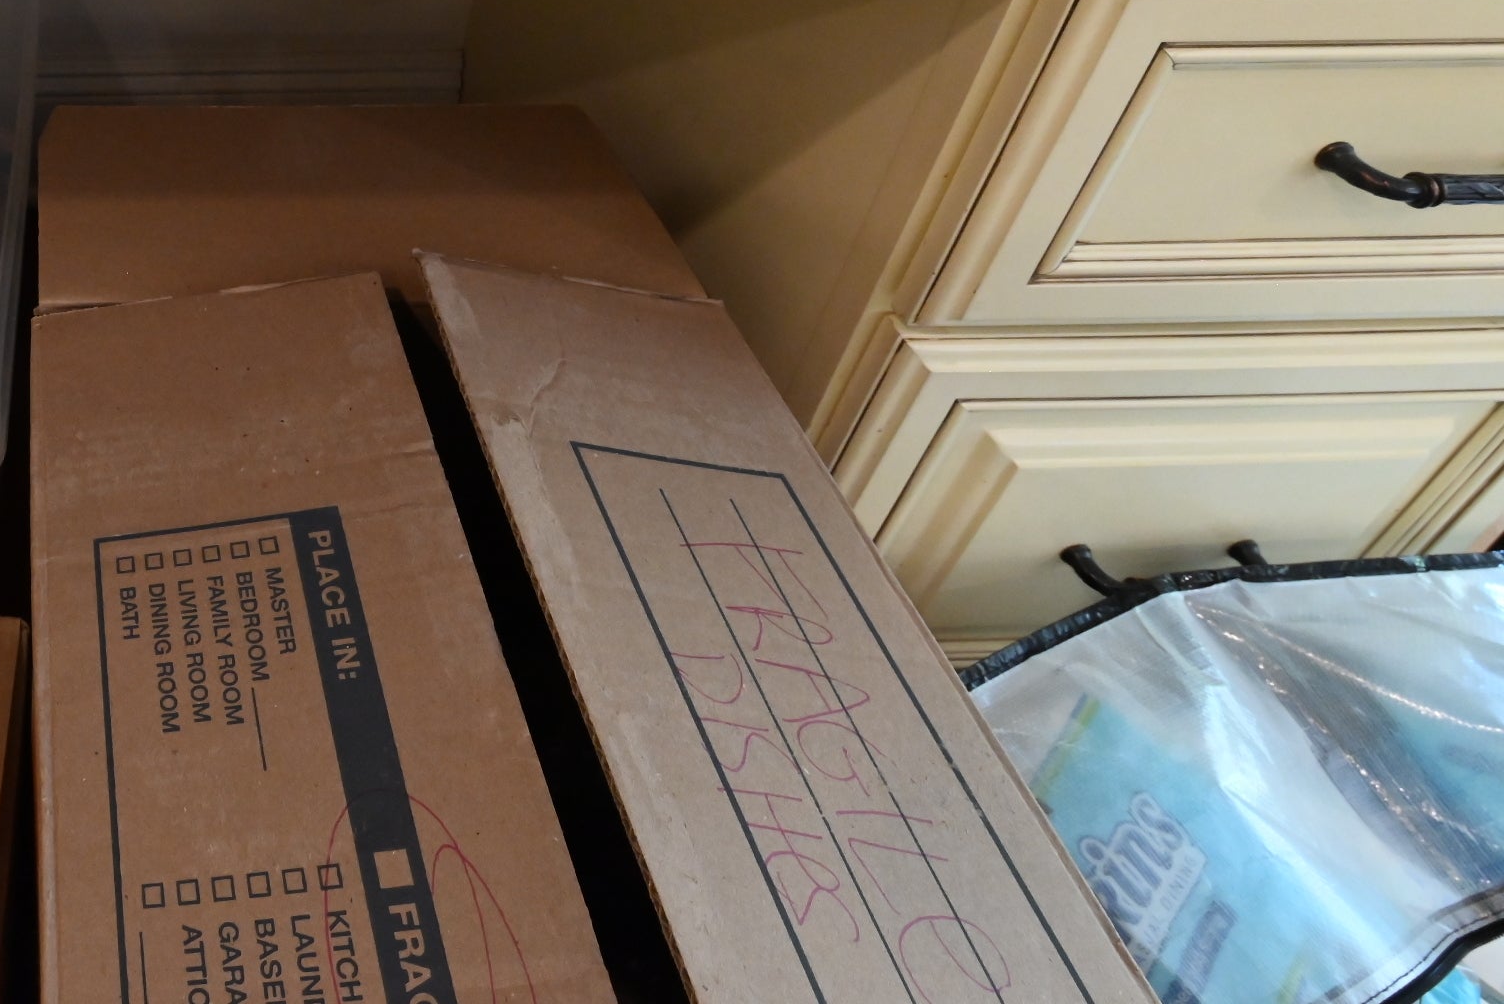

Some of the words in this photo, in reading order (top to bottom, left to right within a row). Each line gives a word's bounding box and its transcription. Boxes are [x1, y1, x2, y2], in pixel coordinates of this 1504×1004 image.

[120, 586, 140, 640] BATH
[148, 583, 172, 656] DINING
[178, 579, 201, 646] LIVING
[207, 575, 233, 647] FAMILY
[236, 572, 270, 682] BEDROOM
[265, 567, 296, 655] MASTER
[308, 529, 351, 628] PLACE
[331, 637, 361, 680] IN:
[156, 661, 180, 734] ROOM
[186, 652, 212, 723] ROOM
[218, 654, 245, 726] ROOM
[182, 924, 210, 1004] ATTIC
[254, 917, 285, 1004] BASE
[290, 914, 323, 1004] LAUN
[327, 910, 363, 1004] KITCH
